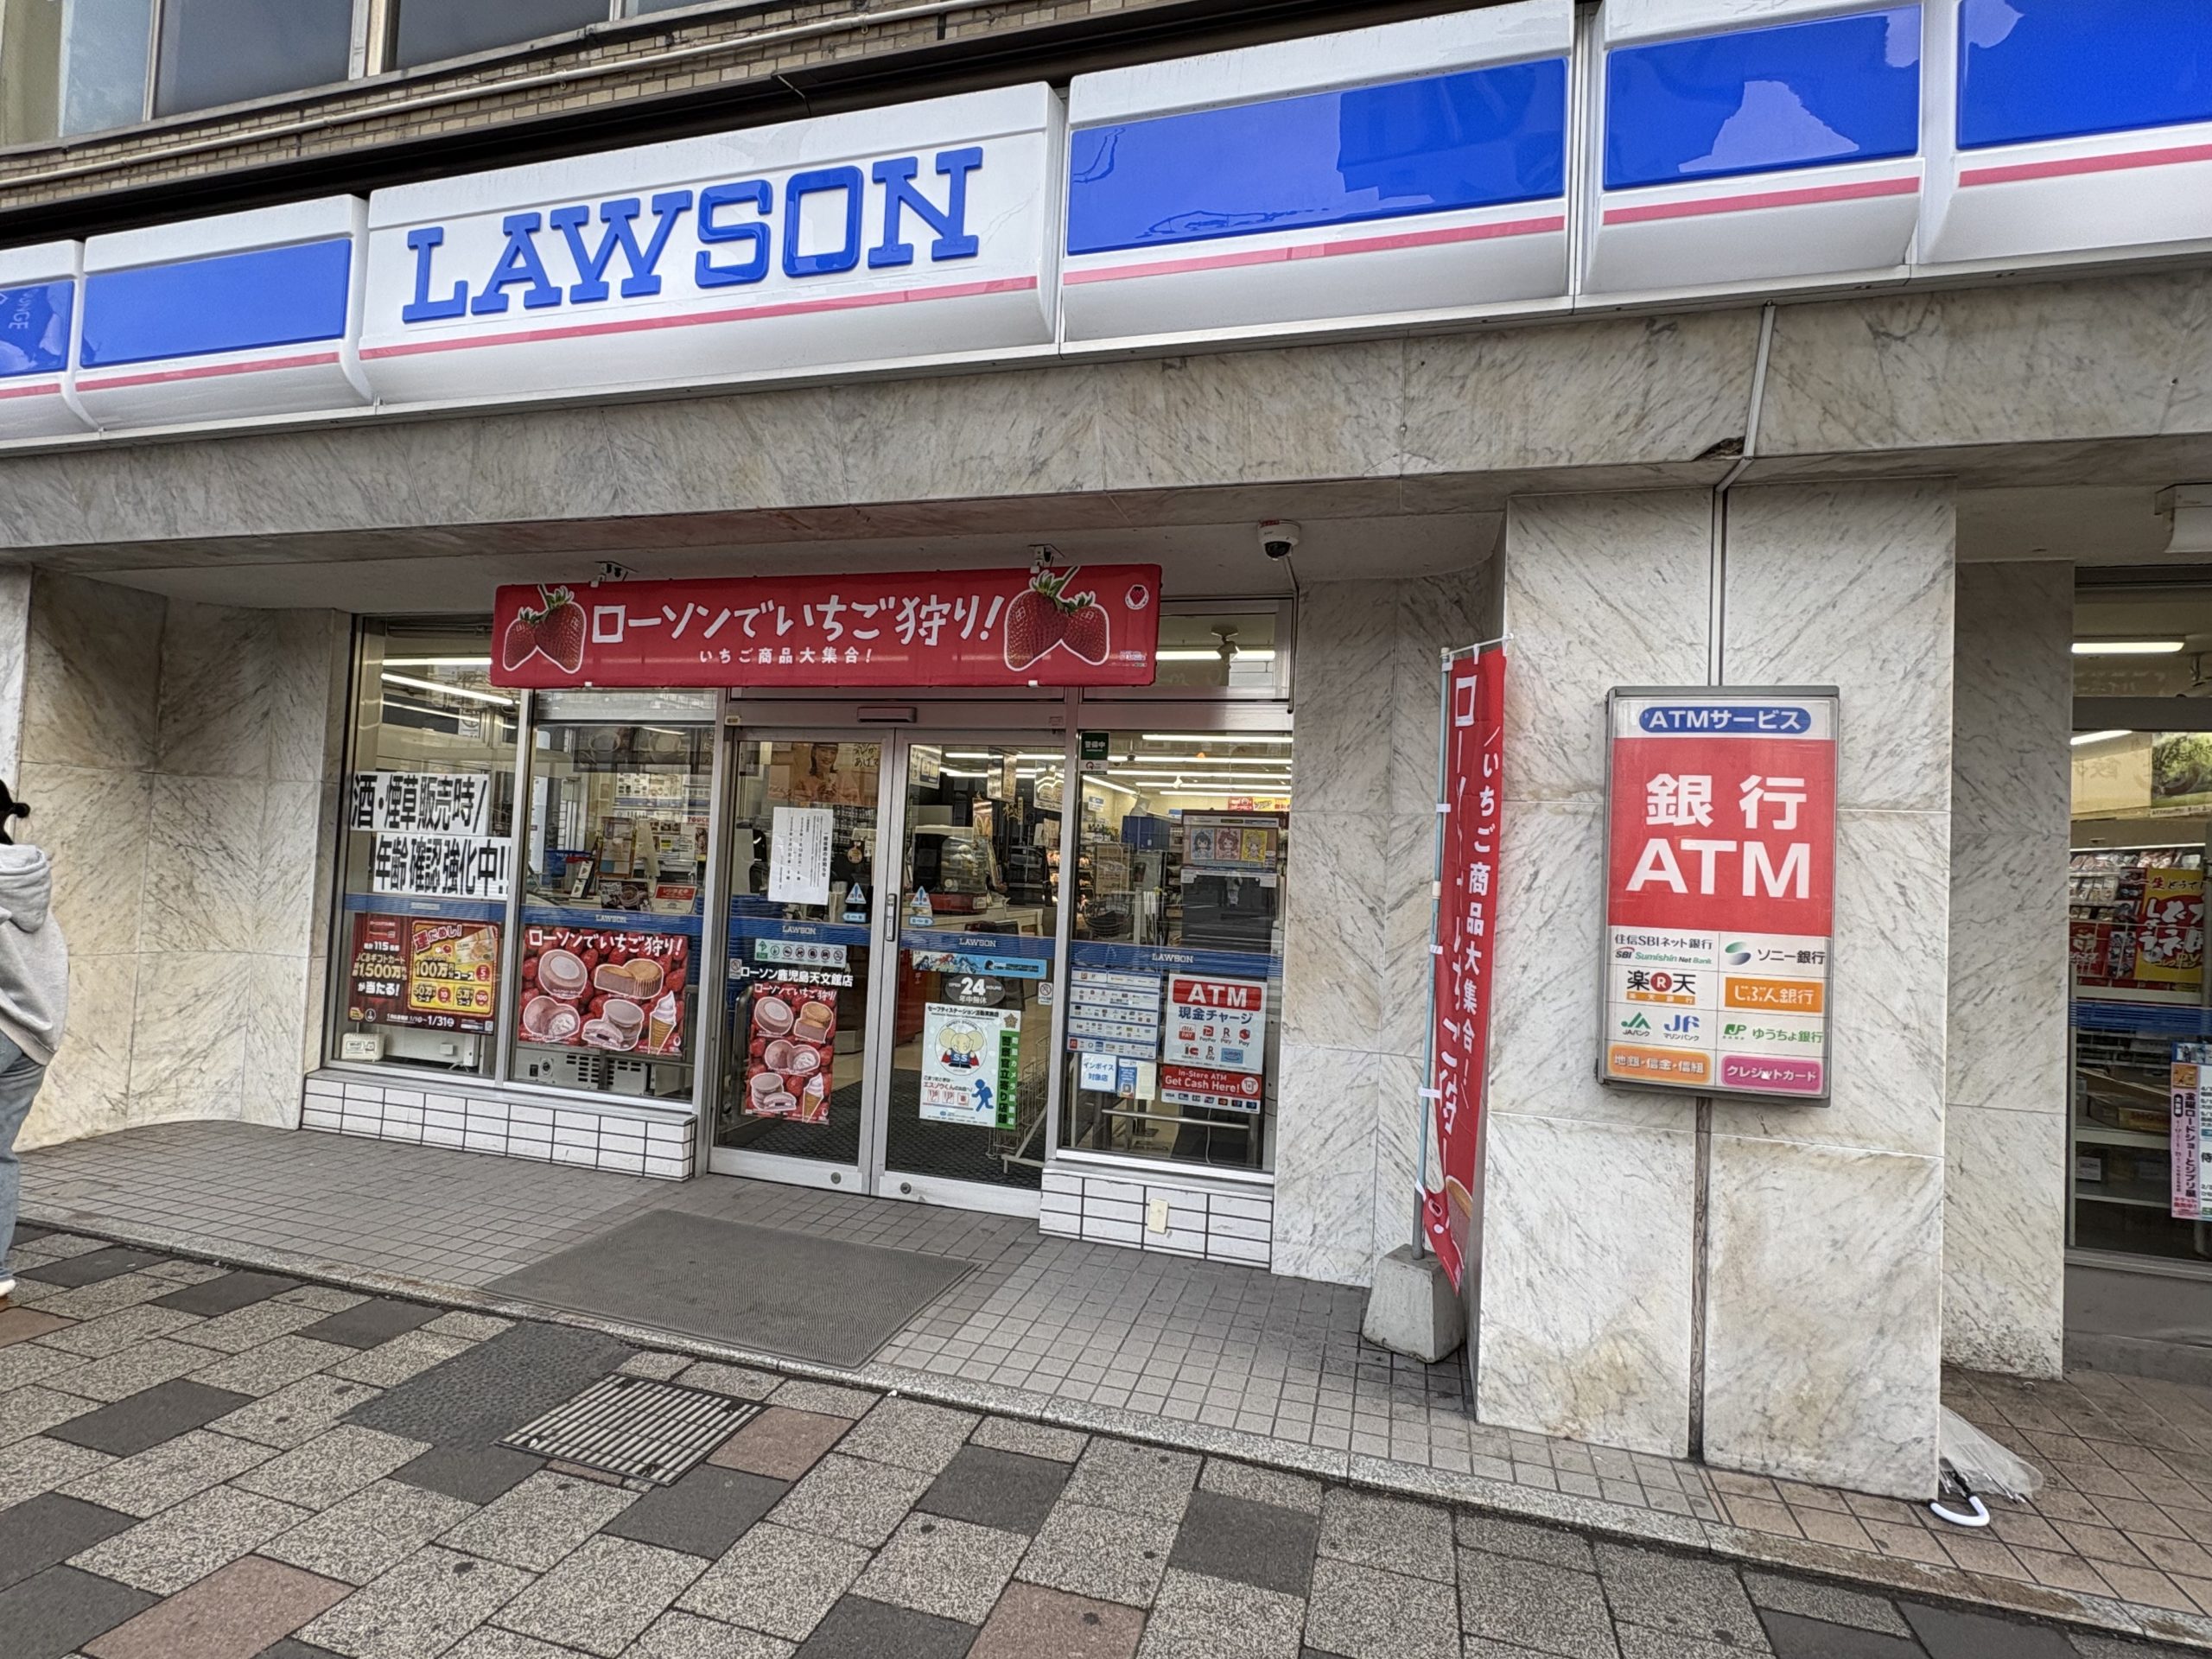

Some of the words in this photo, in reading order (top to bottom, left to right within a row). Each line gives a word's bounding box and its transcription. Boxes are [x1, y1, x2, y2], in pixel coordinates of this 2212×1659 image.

[402, 146, 983, 324] LAWSON
[1649, 710, 1802, 730] ATMサービス
[1625, 838, 1811, 899] ATM
[782, 925, 817, 935] LAWSON
[959, 938, 997, 948] LAWSON
[1615, 934, 1713, 950] 住信SBIネット銀行
[1152, 953, 1194, 963] LAWSON
[1615, 950, 1632, 959] SBI
[1635, 951, 1677, 963] Sumishin
[1758, 949, 1826, 965] ソニー銀行
[741, 966, 854, 988] ローソン鹿児島天文館店
[961, 976, 986, 995] 24
[1187, 983, 1248, 1008] ATM
[1734, 984, 1815, 1005] じぶん銀行
[1179, 1007, 1254, 1025] 現金チャージ
[1662, 1033, 1700, 1041] マリンバンク
[1752, 1028, 1824, 1044] ゆうちょ銀行
[953, 1052, 969, 1063] SS
[1084, 1061, 1115, 1071] インボイス
[1178, 1069, 1209, 1079] In-Store
[1726, 1065, 1817, 1084] クレジットカード
[1165, 1076, 1182, 1086] Get
[1185, 1077, 1209, 1090] Cash
[1211, 1080, 1240, 1093] Here!
